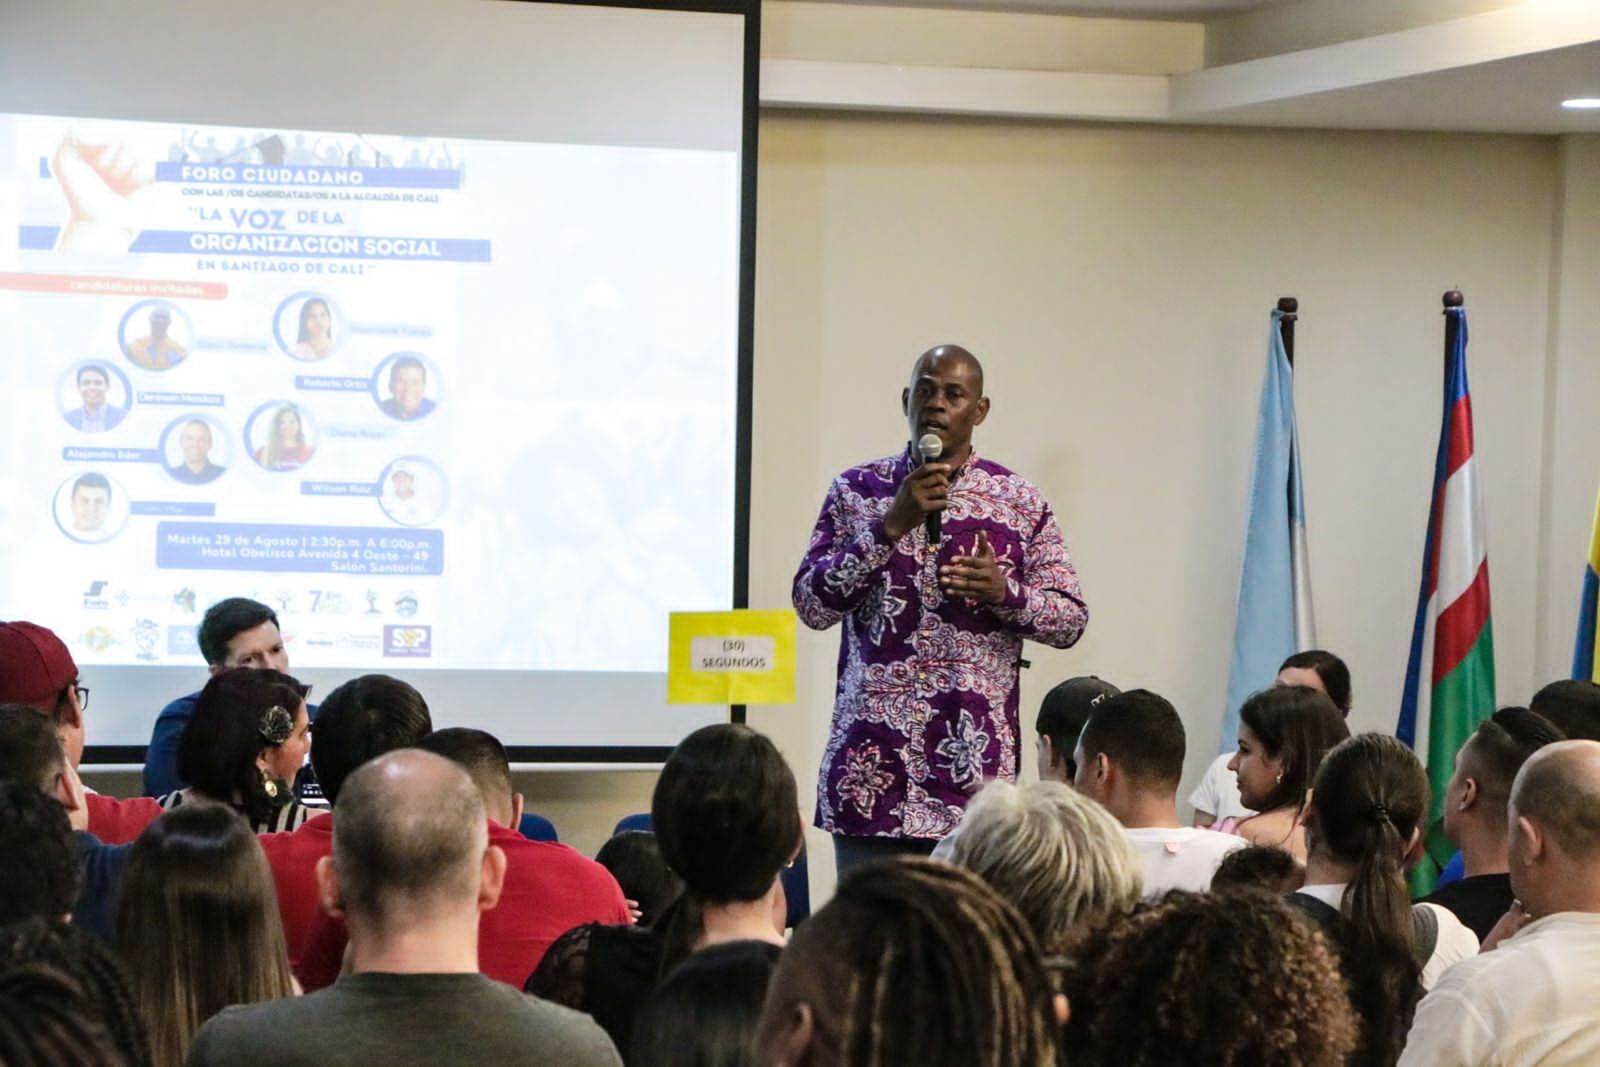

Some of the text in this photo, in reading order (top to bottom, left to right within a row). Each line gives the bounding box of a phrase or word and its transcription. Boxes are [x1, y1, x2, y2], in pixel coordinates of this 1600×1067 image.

[182, 166, 364, 185] FORO CIUDADANO
[181, 187, 204, 196] CON
[206, 188, 225, 197] LAS
[416, 193, 439, 204] CALI
[229, 207, 287, 231] VOZ
[297, 210, 319, 224] DE
[323, 211, 344, 225] LA
[364, 239, 442, 256] SOCIAL
[197, 260, 216, 271] EN
[221, 260, 300, 273] SANTIAGO
[305, 262, 323, 273] DE
[167, 533, 211, 545] Martes
[234, 535, 251, 546] de
[253, 535, 299, 548] Agosto
[367, 538, 377, 548] A
[201, 546, 237, 557] Hotel
[240, 547, 296, 558] Obelisco
[298, 548, 349, 559] Avenida
[351, 549, 360, 559] 4
[363, 550, 400, 561] Oeste
[722, 639, 745, 653] (30)
[702, 656, 766, 669] SEGUNDOS
